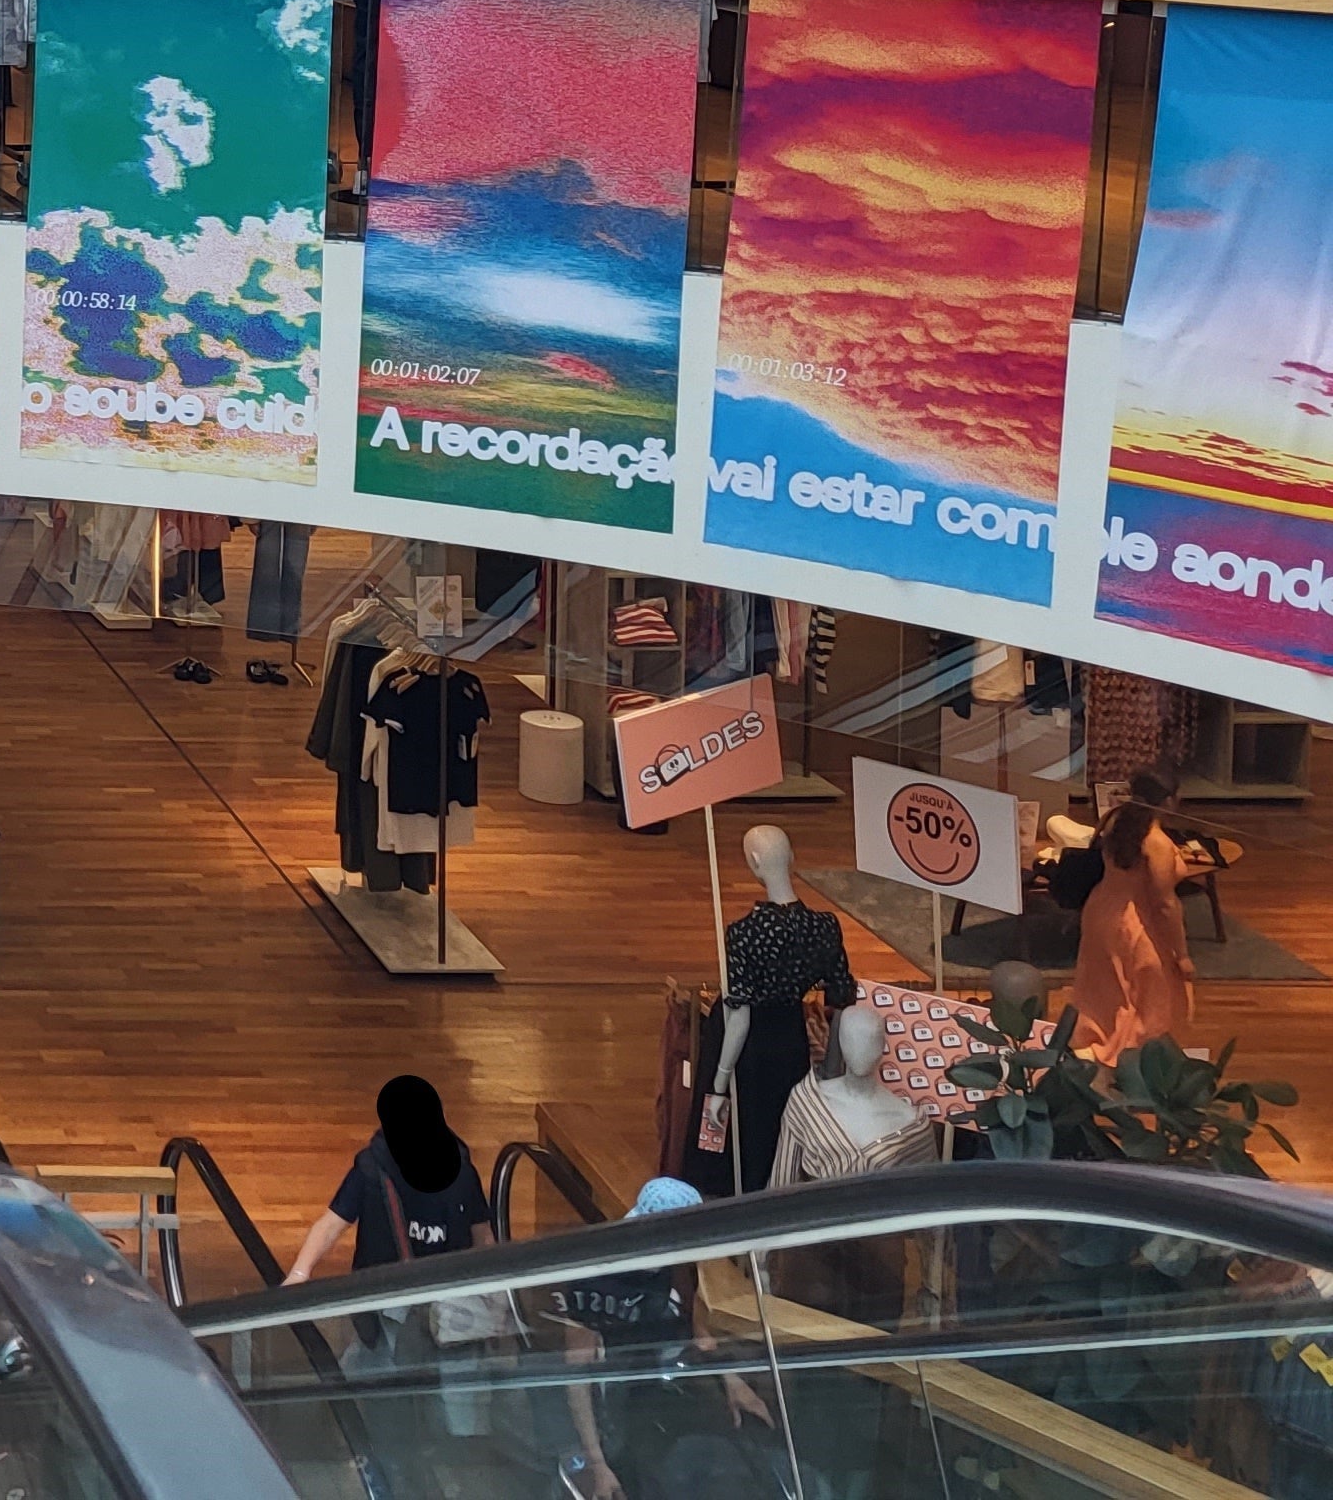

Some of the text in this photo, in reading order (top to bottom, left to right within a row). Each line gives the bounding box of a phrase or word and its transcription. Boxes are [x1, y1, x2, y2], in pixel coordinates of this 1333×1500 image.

[34, 289, 137, 312] 00:00:58:14
[370, 358, 481, 386] 00:01:02:07
[729, 352, 848, 388] 00:01:03:12
[63, 382, 205, 427] soube
[369, 405, 411, 451] A
[707, 454, 778, 502] vai
[788, 470, 926, 526] estar
[909, 790, 956, 812] JUSQU'À
[893, 806, 973, 850] -50%
